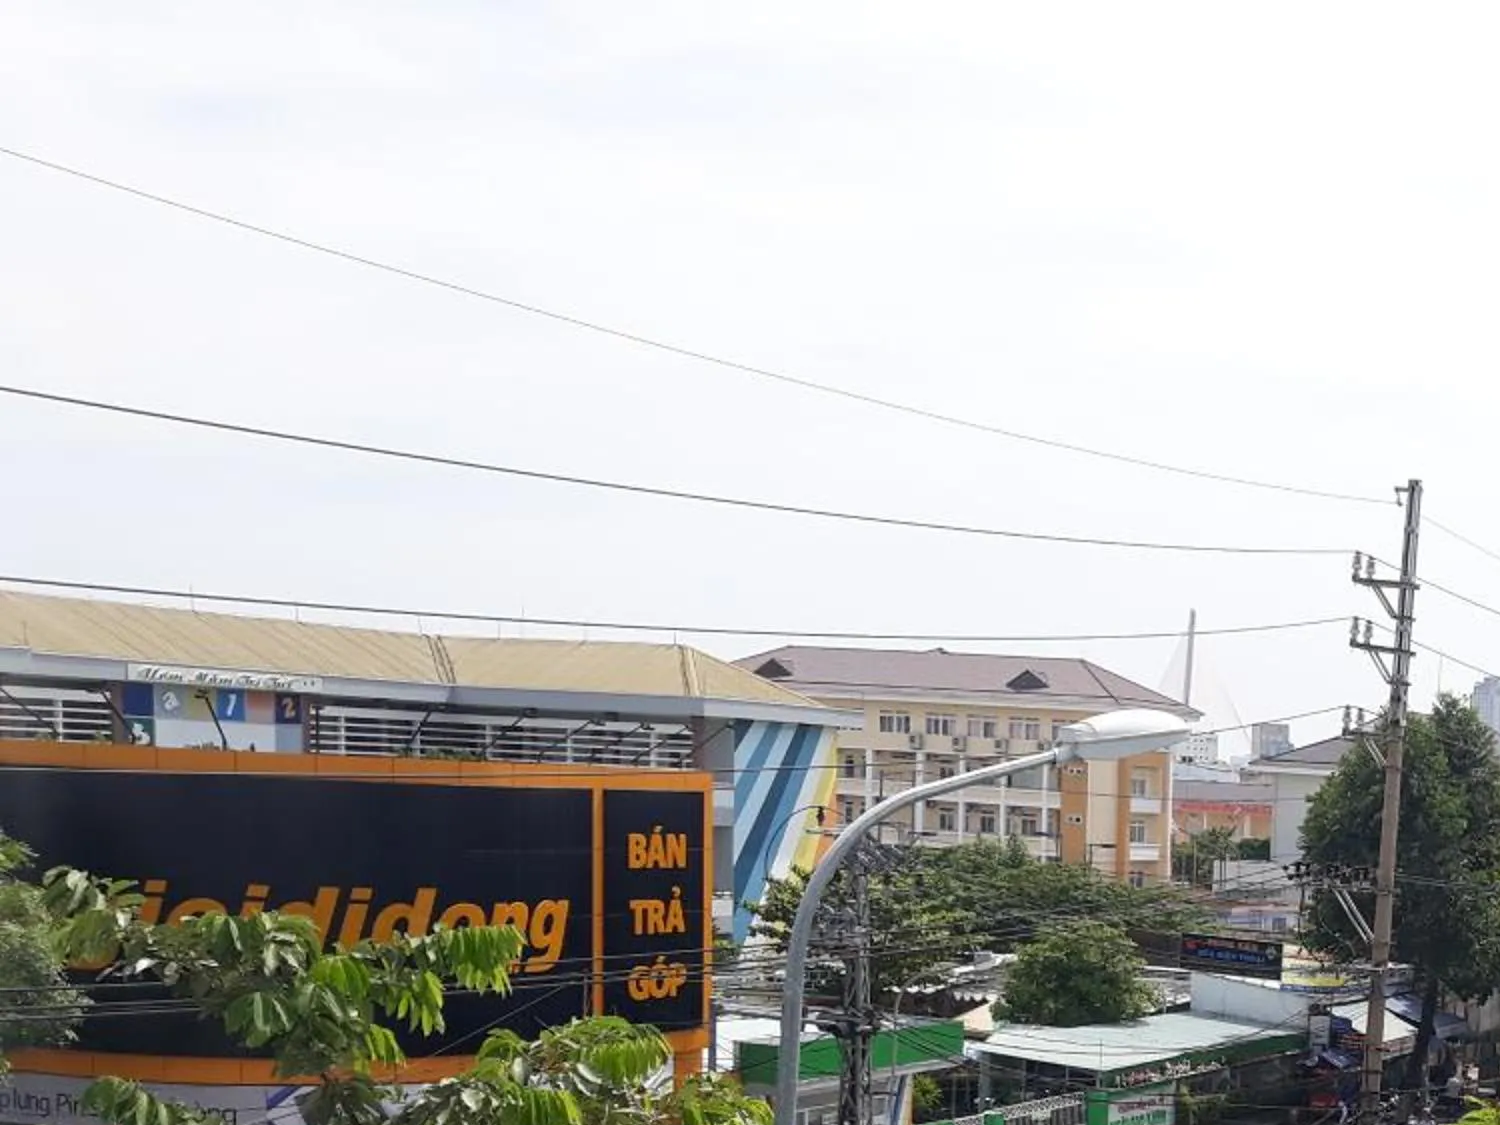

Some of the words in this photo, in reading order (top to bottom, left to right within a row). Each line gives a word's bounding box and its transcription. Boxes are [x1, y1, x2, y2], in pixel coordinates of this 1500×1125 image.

[627, 825, 687, 869] BÁN
[629, 885, 686, 934] TRẢ
[627, 956, 687, 1001] GÓP
